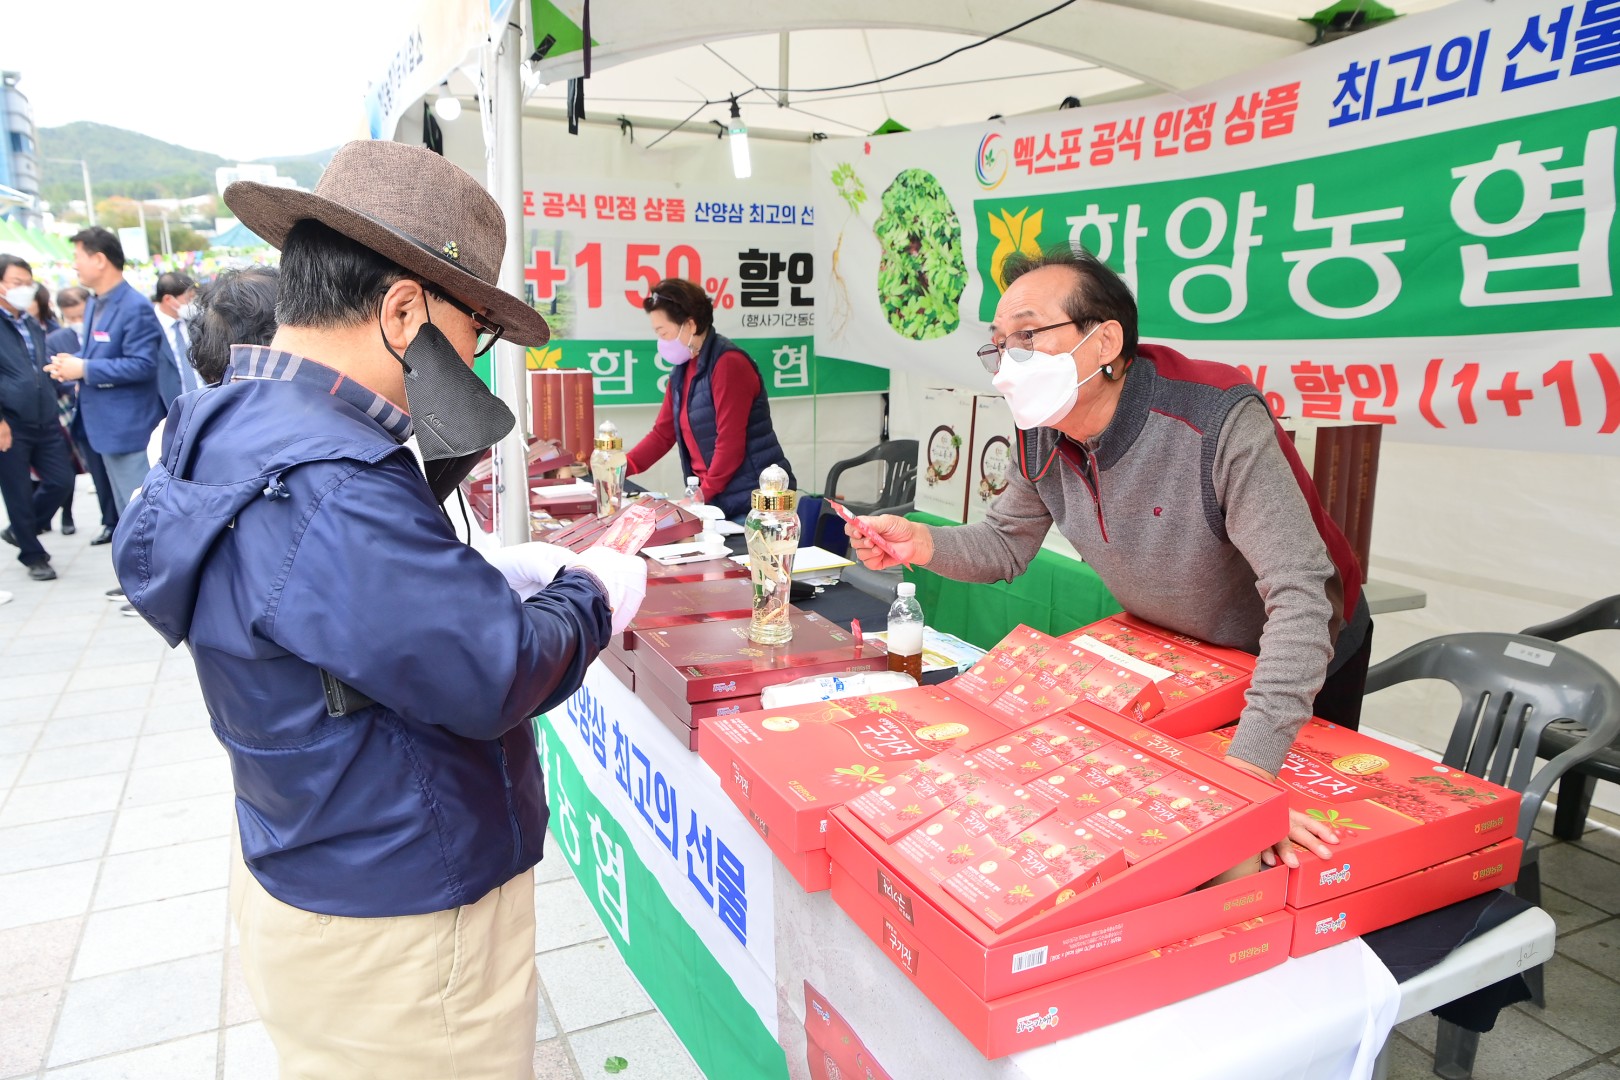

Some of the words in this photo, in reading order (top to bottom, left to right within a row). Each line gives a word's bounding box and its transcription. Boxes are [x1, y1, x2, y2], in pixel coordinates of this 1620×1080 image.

[1328, 29, 1490, 127] 최고의
[1013, 128, 1081, 175] 엑스포
[1090, 120, 1142, 167] 공식
[1153, 102, 1216, 157] 인정
[1224, 81, 1301, 146] 상품
[543, 192, 586, 219] 공식
[595, 195, 636, 221] 인정
[643, 198, 685, 223] 상품
[695, 202, 744, 223] 산양삼
[749, 204, 796, 225] 최고의
[1291, 360, 1398, 425] 할인
[860, 725, 919, 756] 구기자
[1280, 758, 1358, 796] 구기자
[612, 720, 679, 861] 최고의
[685, 808, 747, 949] 선물
[889, 932, 912, 966] 구기자
